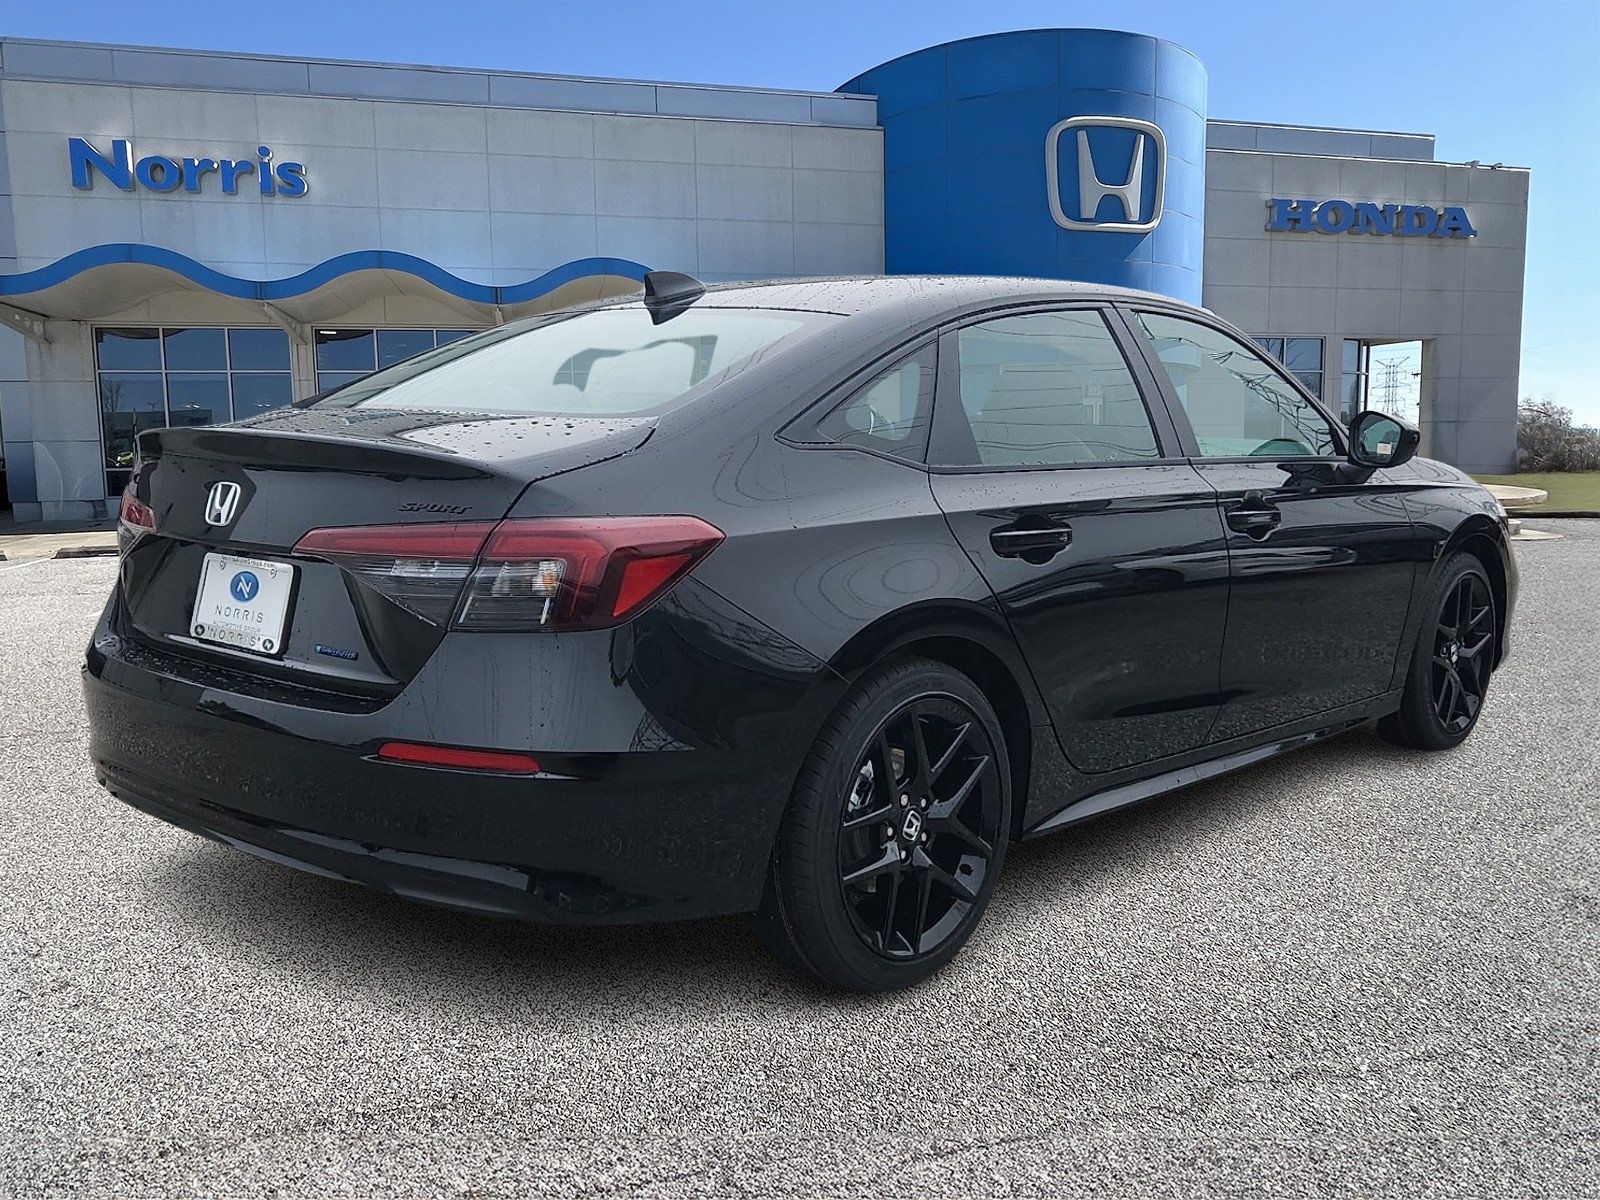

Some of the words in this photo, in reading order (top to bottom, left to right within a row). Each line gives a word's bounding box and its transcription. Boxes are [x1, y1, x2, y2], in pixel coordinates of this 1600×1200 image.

[68, 137, 308, 197] Norris
[1265, 198, 1478, 239] HONDA
[398, 502, 474, 514] SPORT
[214, 605, 264, 623] NORRIS
